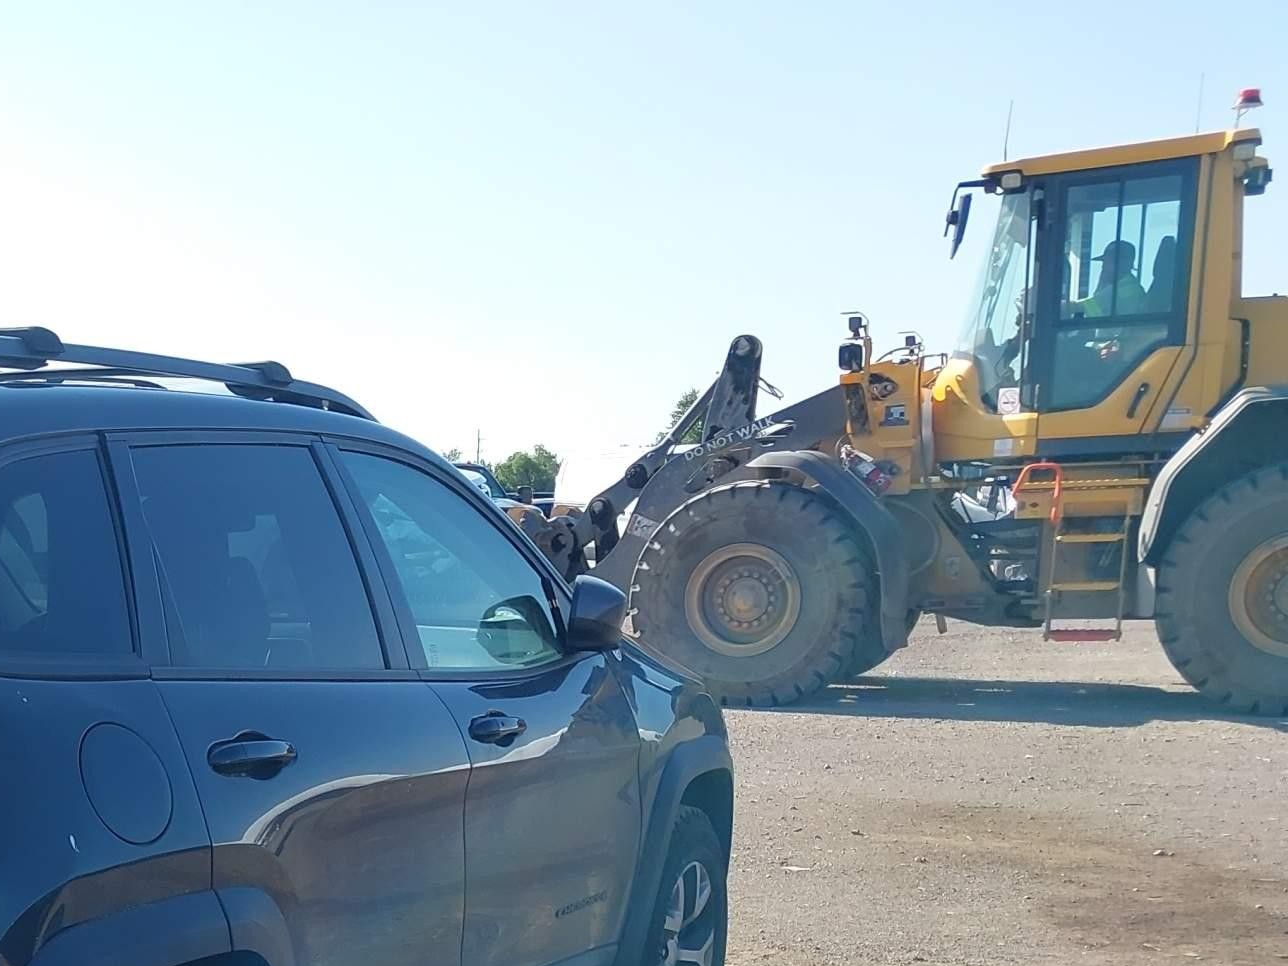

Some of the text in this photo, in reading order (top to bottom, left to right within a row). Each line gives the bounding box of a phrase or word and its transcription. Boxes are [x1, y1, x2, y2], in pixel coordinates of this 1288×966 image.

[684, 446, 705, 461] DO
[706, 432, 735, 452] NOT
[735, 416, 777, 440] WALK
